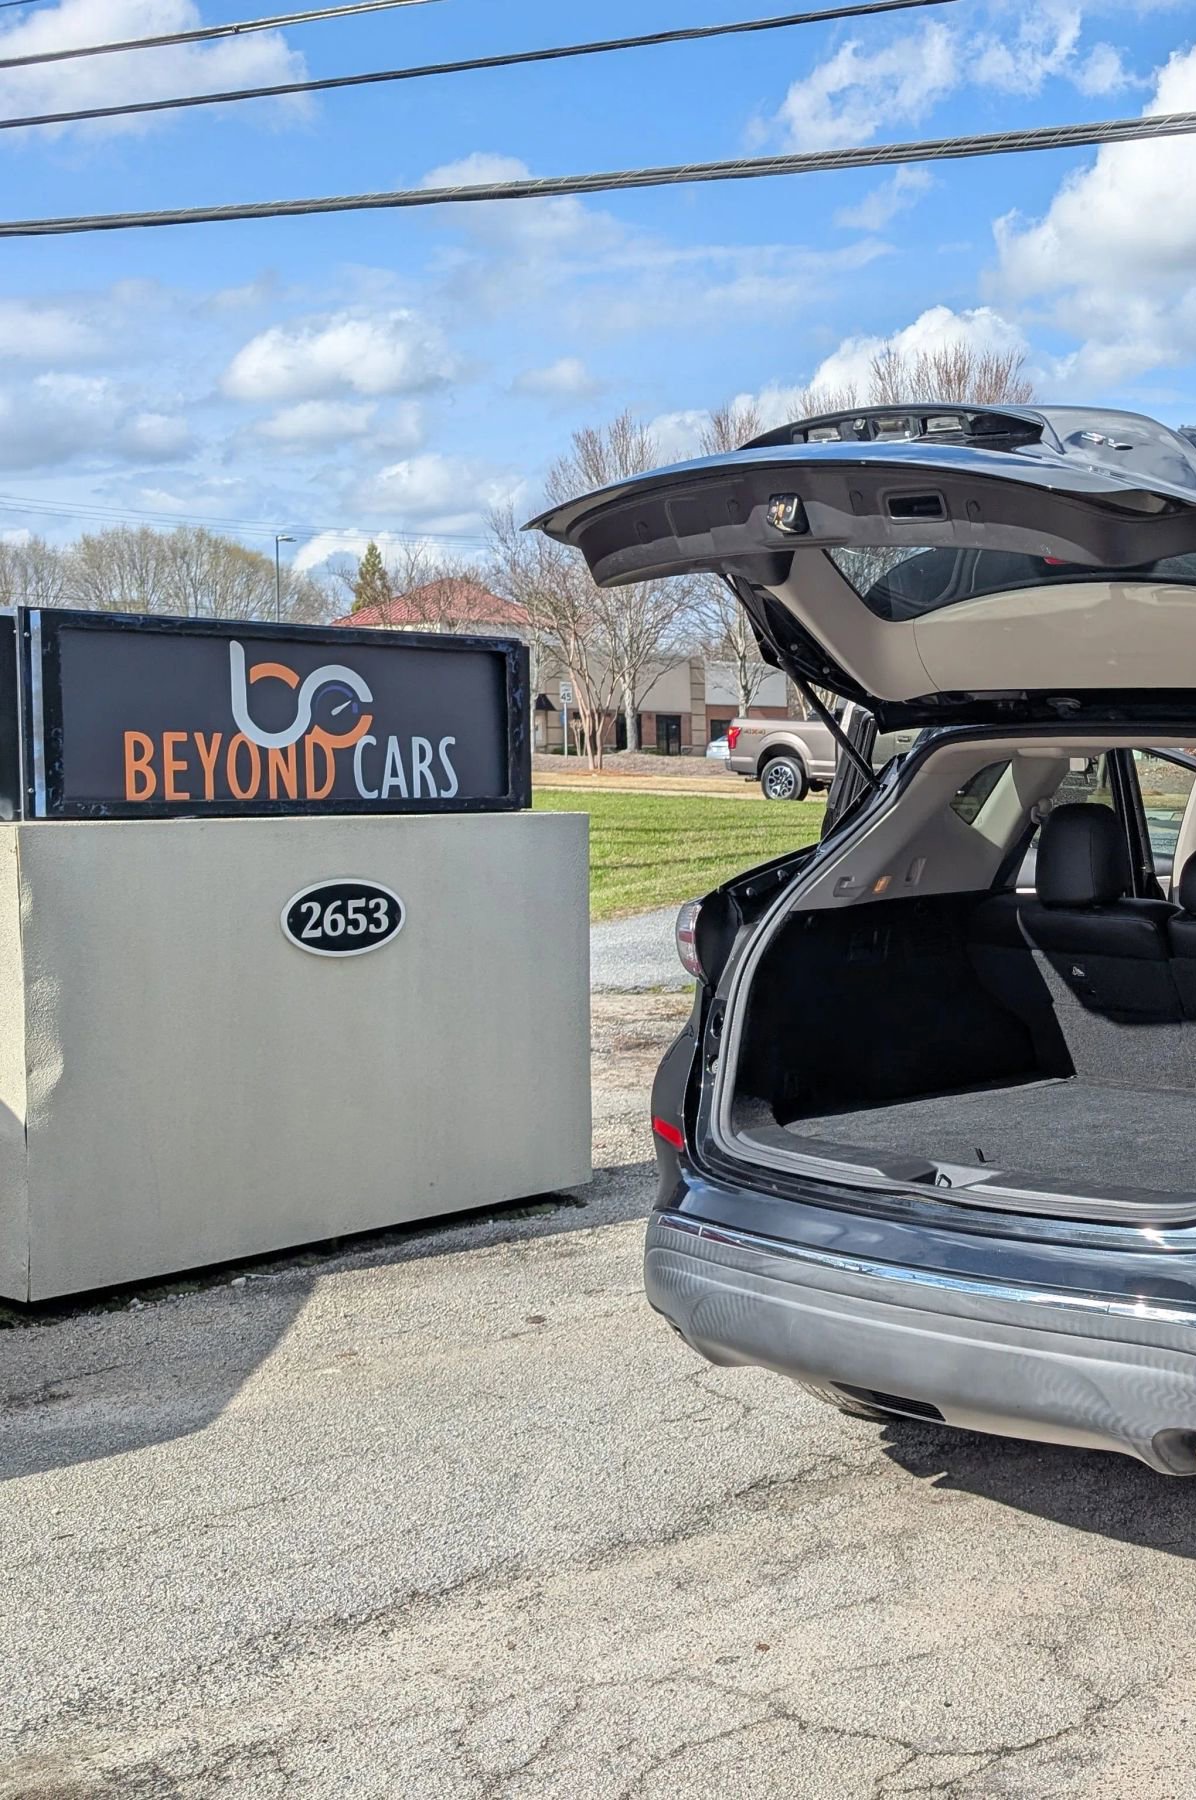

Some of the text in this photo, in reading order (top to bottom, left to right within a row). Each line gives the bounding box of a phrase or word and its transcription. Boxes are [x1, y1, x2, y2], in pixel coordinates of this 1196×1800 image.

[561, 692, 572, 702] 45
[124, 731, 459, 801] BEYOND CARS
[300, 897, 389, 938] 2653
